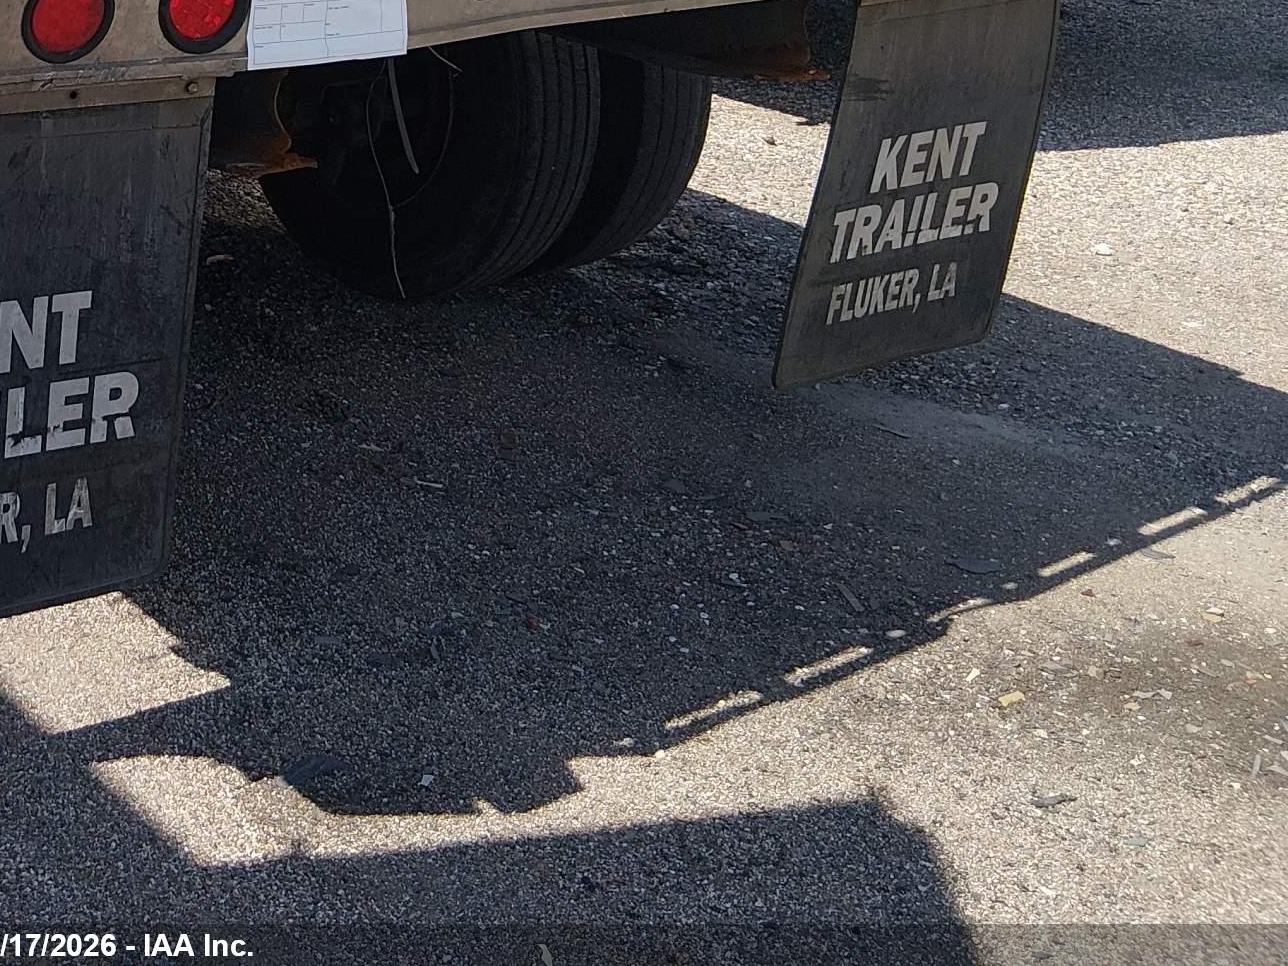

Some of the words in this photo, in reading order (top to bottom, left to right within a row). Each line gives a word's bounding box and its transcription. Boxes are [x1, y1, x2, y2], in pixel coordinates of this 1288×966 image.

[869, 121, 988, 194] KENT
[829, 182, 999, 264] TRAILER
[825, 268, 921, 325] FLUKER,
[928, 261, 958, 301] LA
[44, 476, 93, 536] LA
